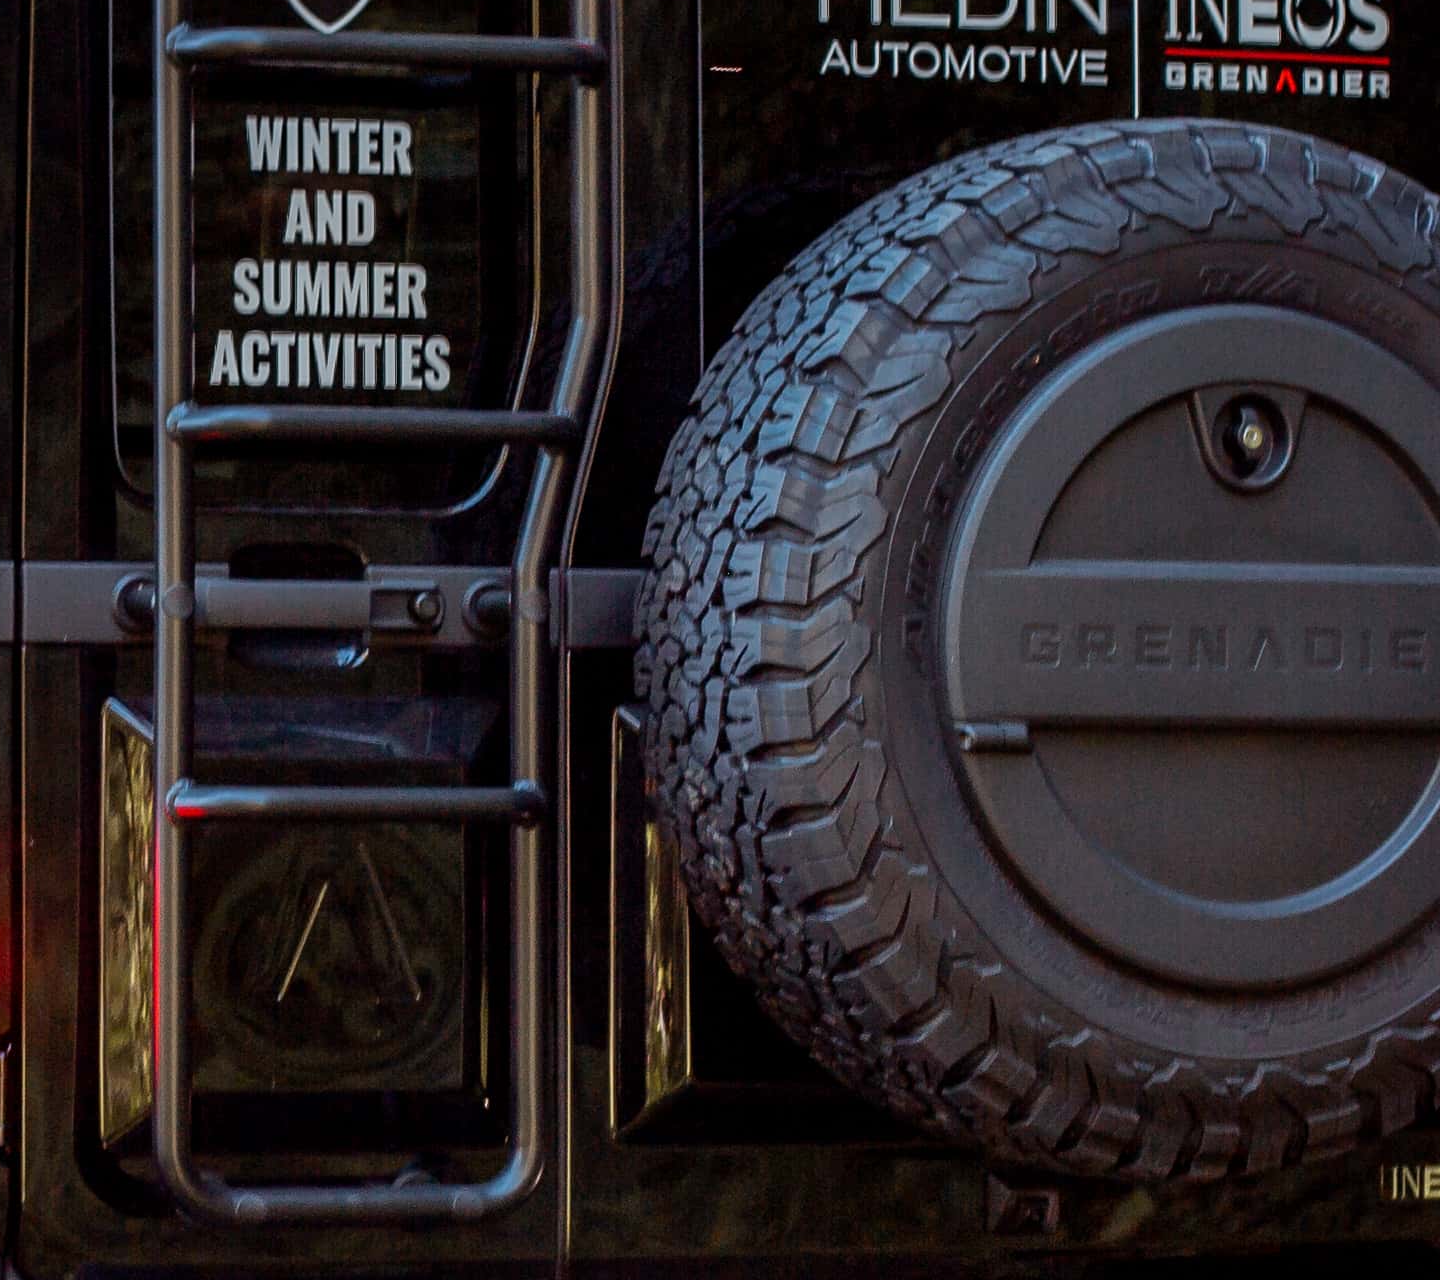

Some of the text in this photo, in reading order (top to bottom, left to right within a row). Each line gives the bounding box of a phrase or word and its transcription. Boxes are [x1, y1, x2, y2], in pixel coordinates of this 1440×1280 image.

[820, 38, 1109, 87] AUTOMOTIVE
[1165, 62, 1391, 99] GRENADIER
[246, 114, 414, 176] WINTER
[283, 189, 376, 246] AND
[233, 258, 427, 319] SUMMER
[209, 329, 451, 391] ACTIVITIES
